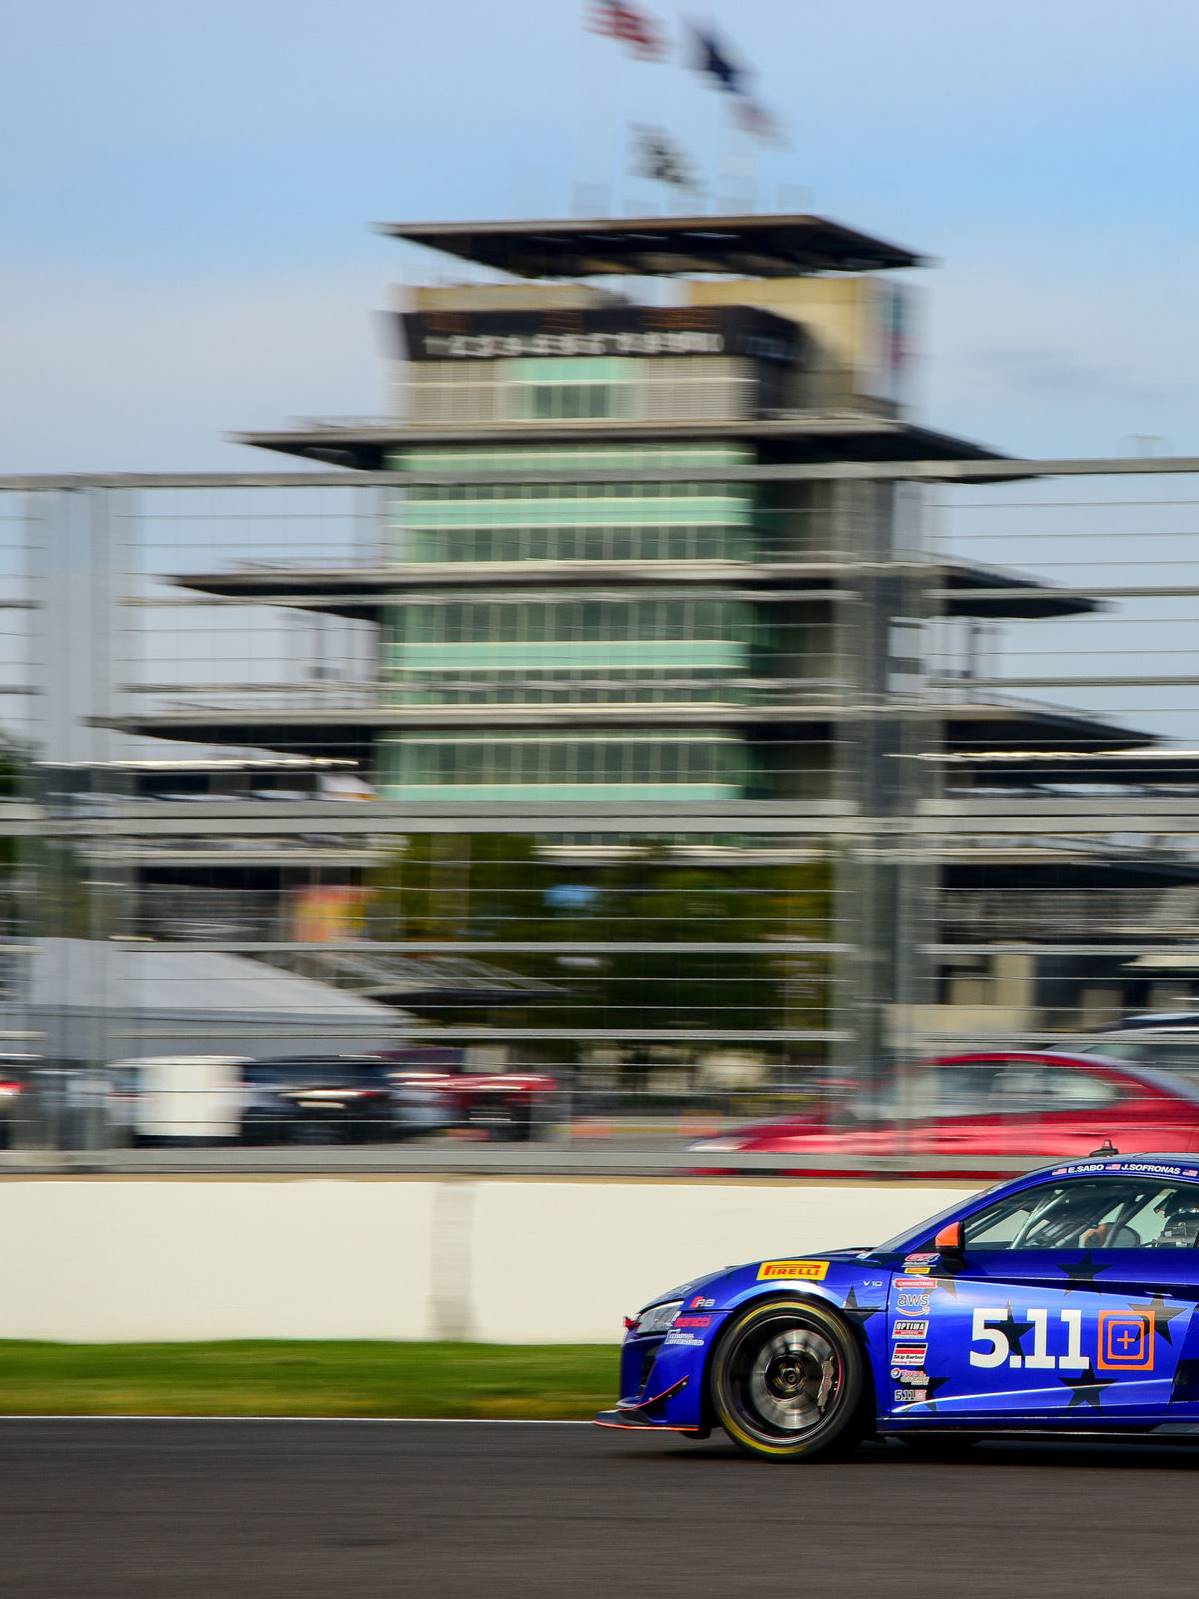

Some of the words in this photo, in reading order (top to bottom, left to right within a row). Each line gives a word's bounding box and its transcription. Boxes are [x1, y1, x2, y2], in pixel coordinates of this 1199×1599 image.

[1067, 1164, 1105, 1174] E.SABO
[1121, 1163, 1181, 1175] J.SOFRONAS
[763, 1264, 822, 1276] PIRELLI
[898, 1293, 929, 1307] aws
[896, 1322, 925, 1331] OPTIMA
[970, 1308, 1090, 1369] 5.11
